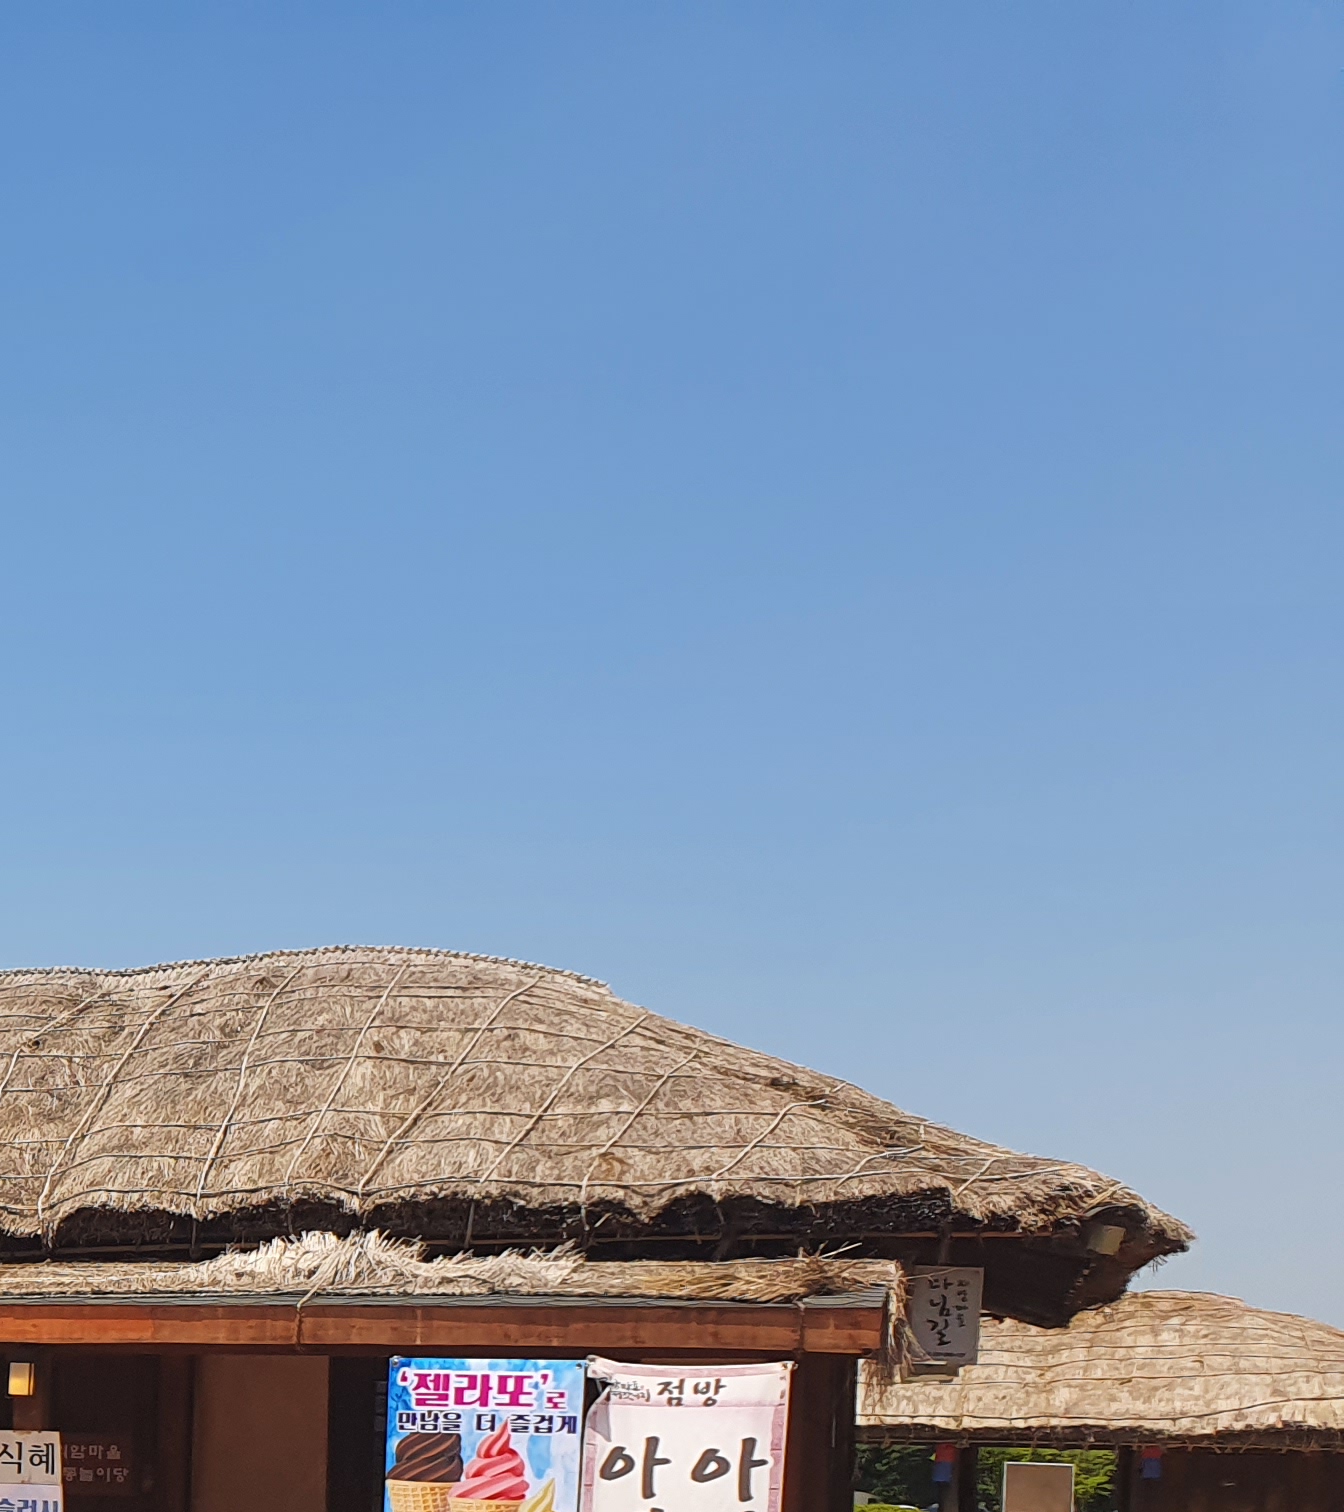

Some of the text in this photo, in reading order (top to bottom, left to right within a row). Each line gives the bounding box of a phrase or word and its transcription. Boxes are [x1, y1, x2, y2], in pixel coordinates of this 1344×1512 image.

[657, 1378, 727, 1407] 점방
[398, 1411, 578, 1434] 만남을 더 즐겁게
